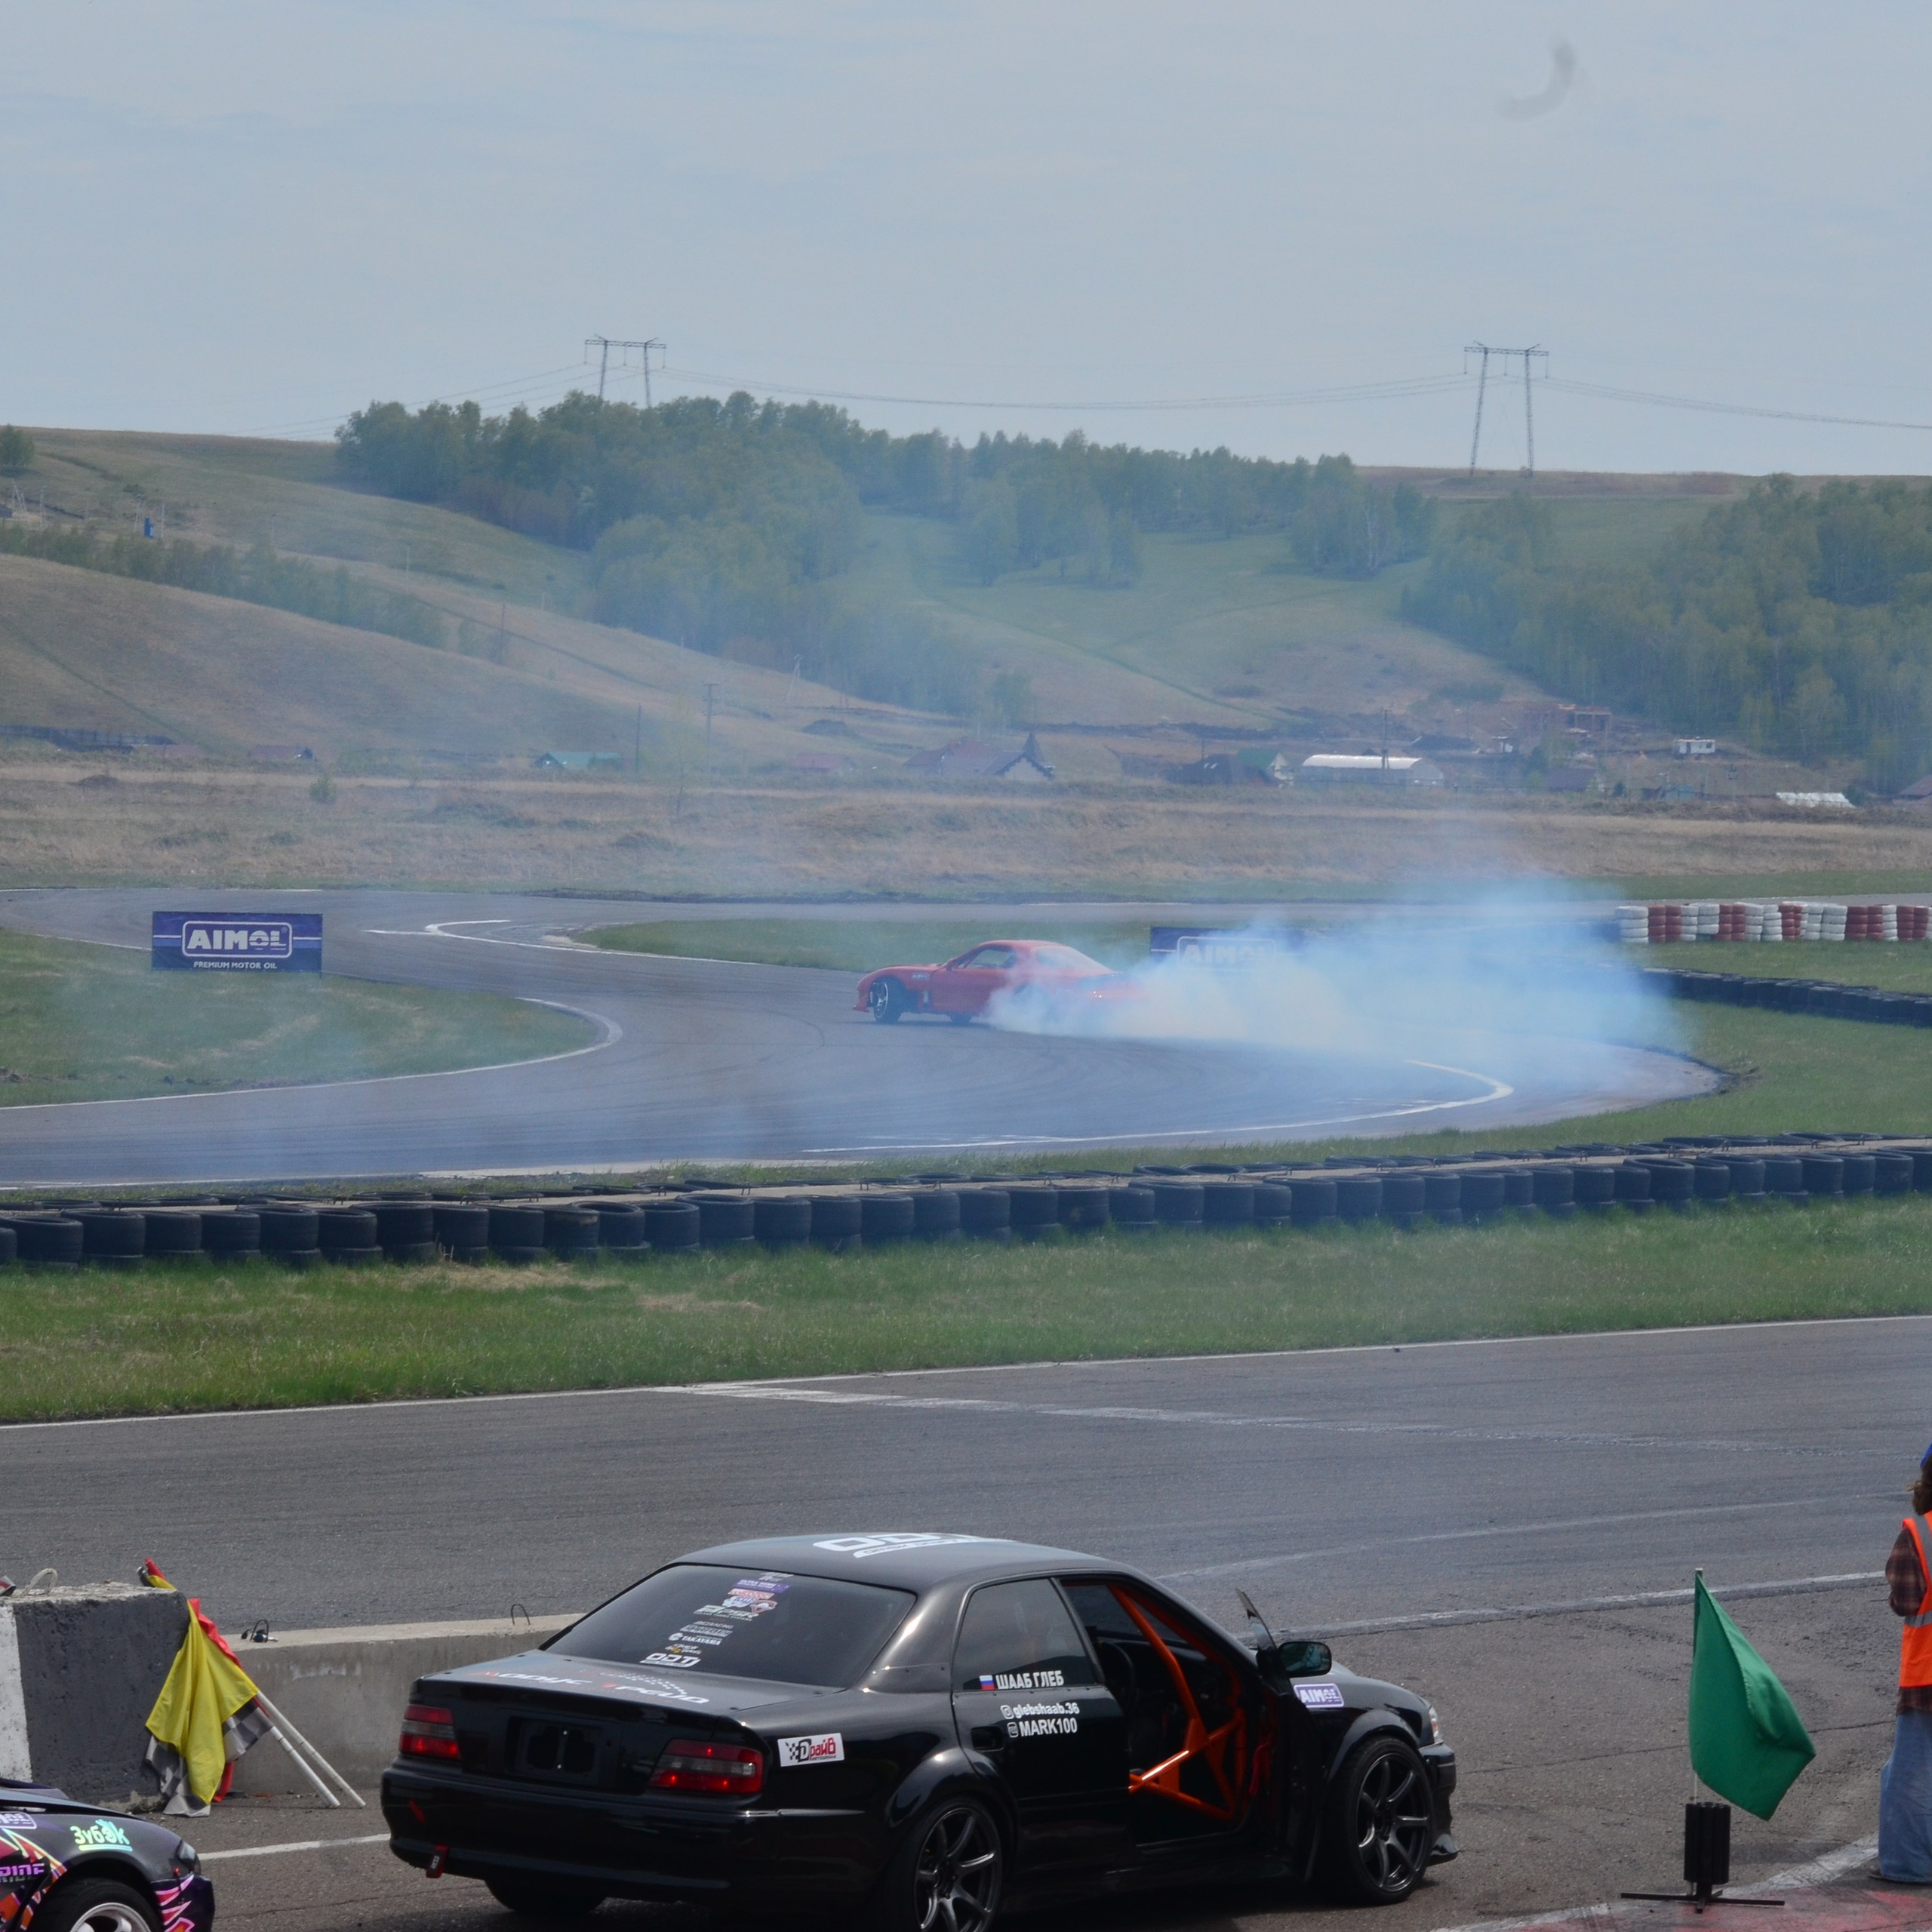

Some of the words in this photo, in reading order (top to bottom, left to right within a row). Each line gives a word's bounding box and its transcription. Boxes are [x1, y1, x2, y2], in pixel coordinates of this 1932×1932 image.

[187, 929, 287, 951] AIMOL
[193, 961, 229, 969] PREMIUM
[231, 961, 261, 970] MOTOR
[681, 1635, 721, 1646] TAKAYAMA
[995, 1672, 1032, 1690] ШААБ
[1032, 1670, 1065, 1687] ГЛЕБ
